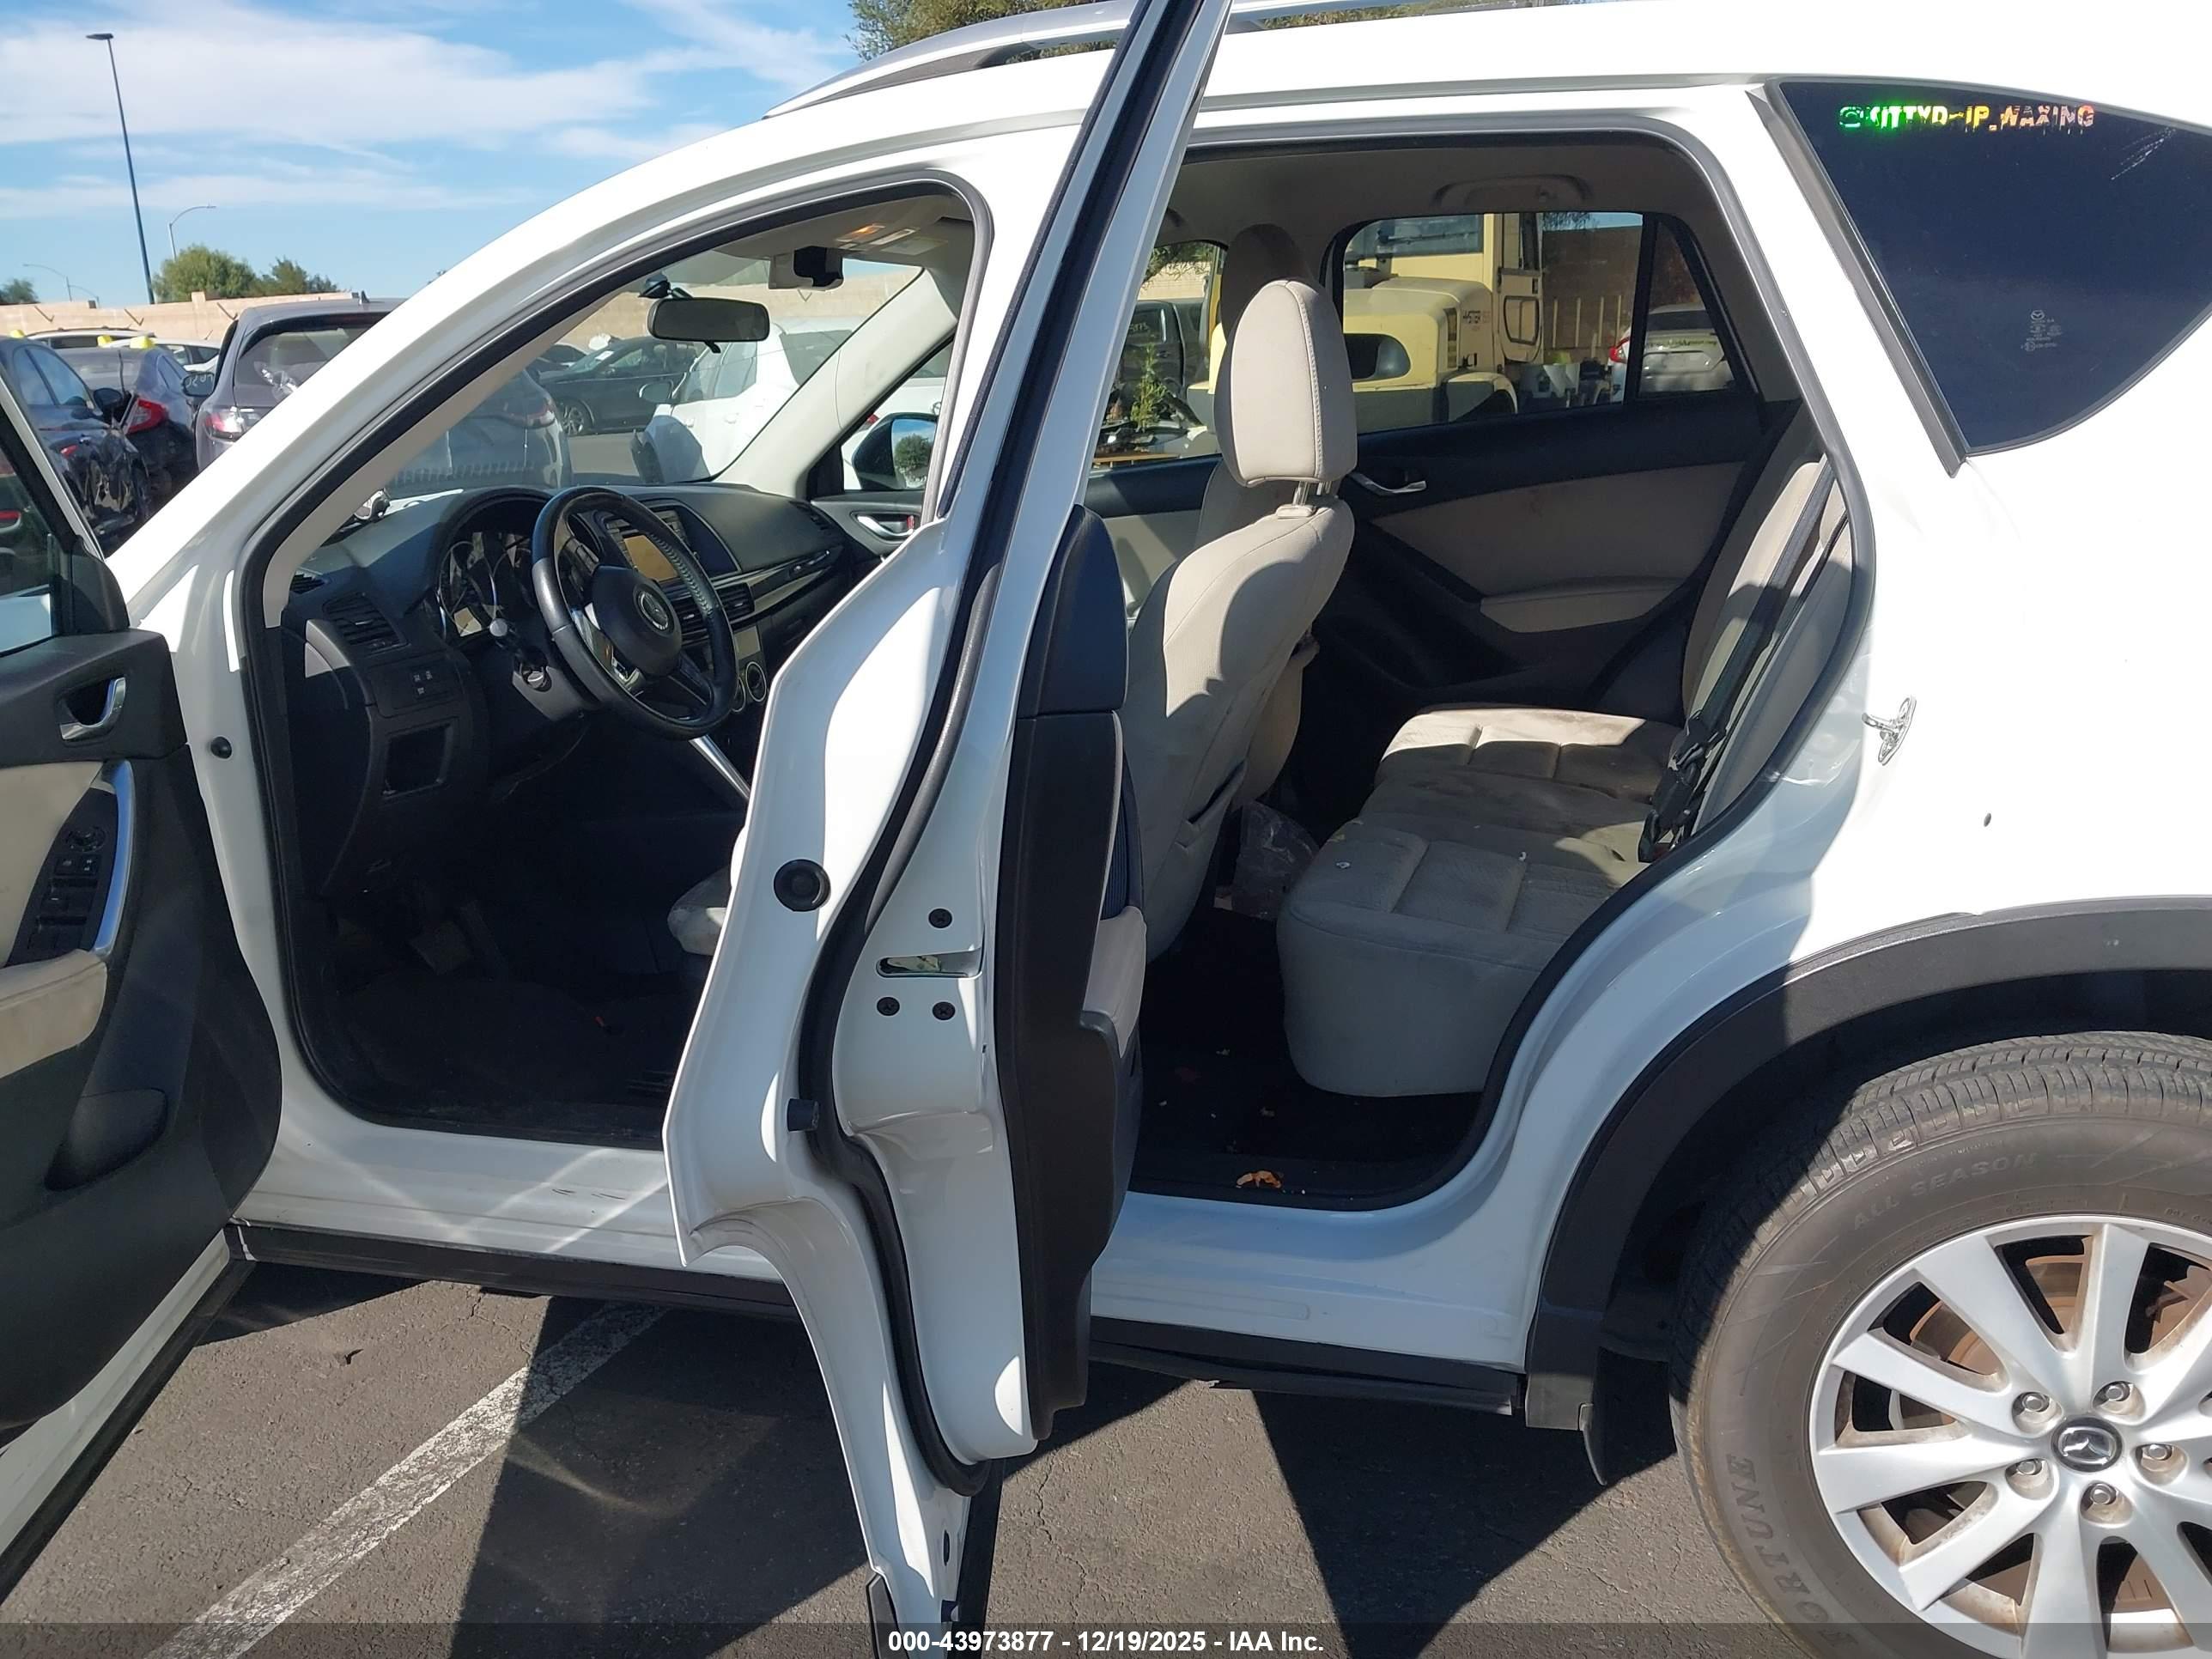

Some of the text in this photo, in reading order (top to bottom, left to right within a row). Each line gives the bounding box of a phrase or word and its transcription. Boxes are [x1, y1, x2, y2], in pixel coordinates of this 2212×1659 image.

[1853, 1194, 1900, 1231] ALL
[1909, 1152, 2038, 1196] SEASON
[1726, 1453, 1859, 1648] FORTUNE
